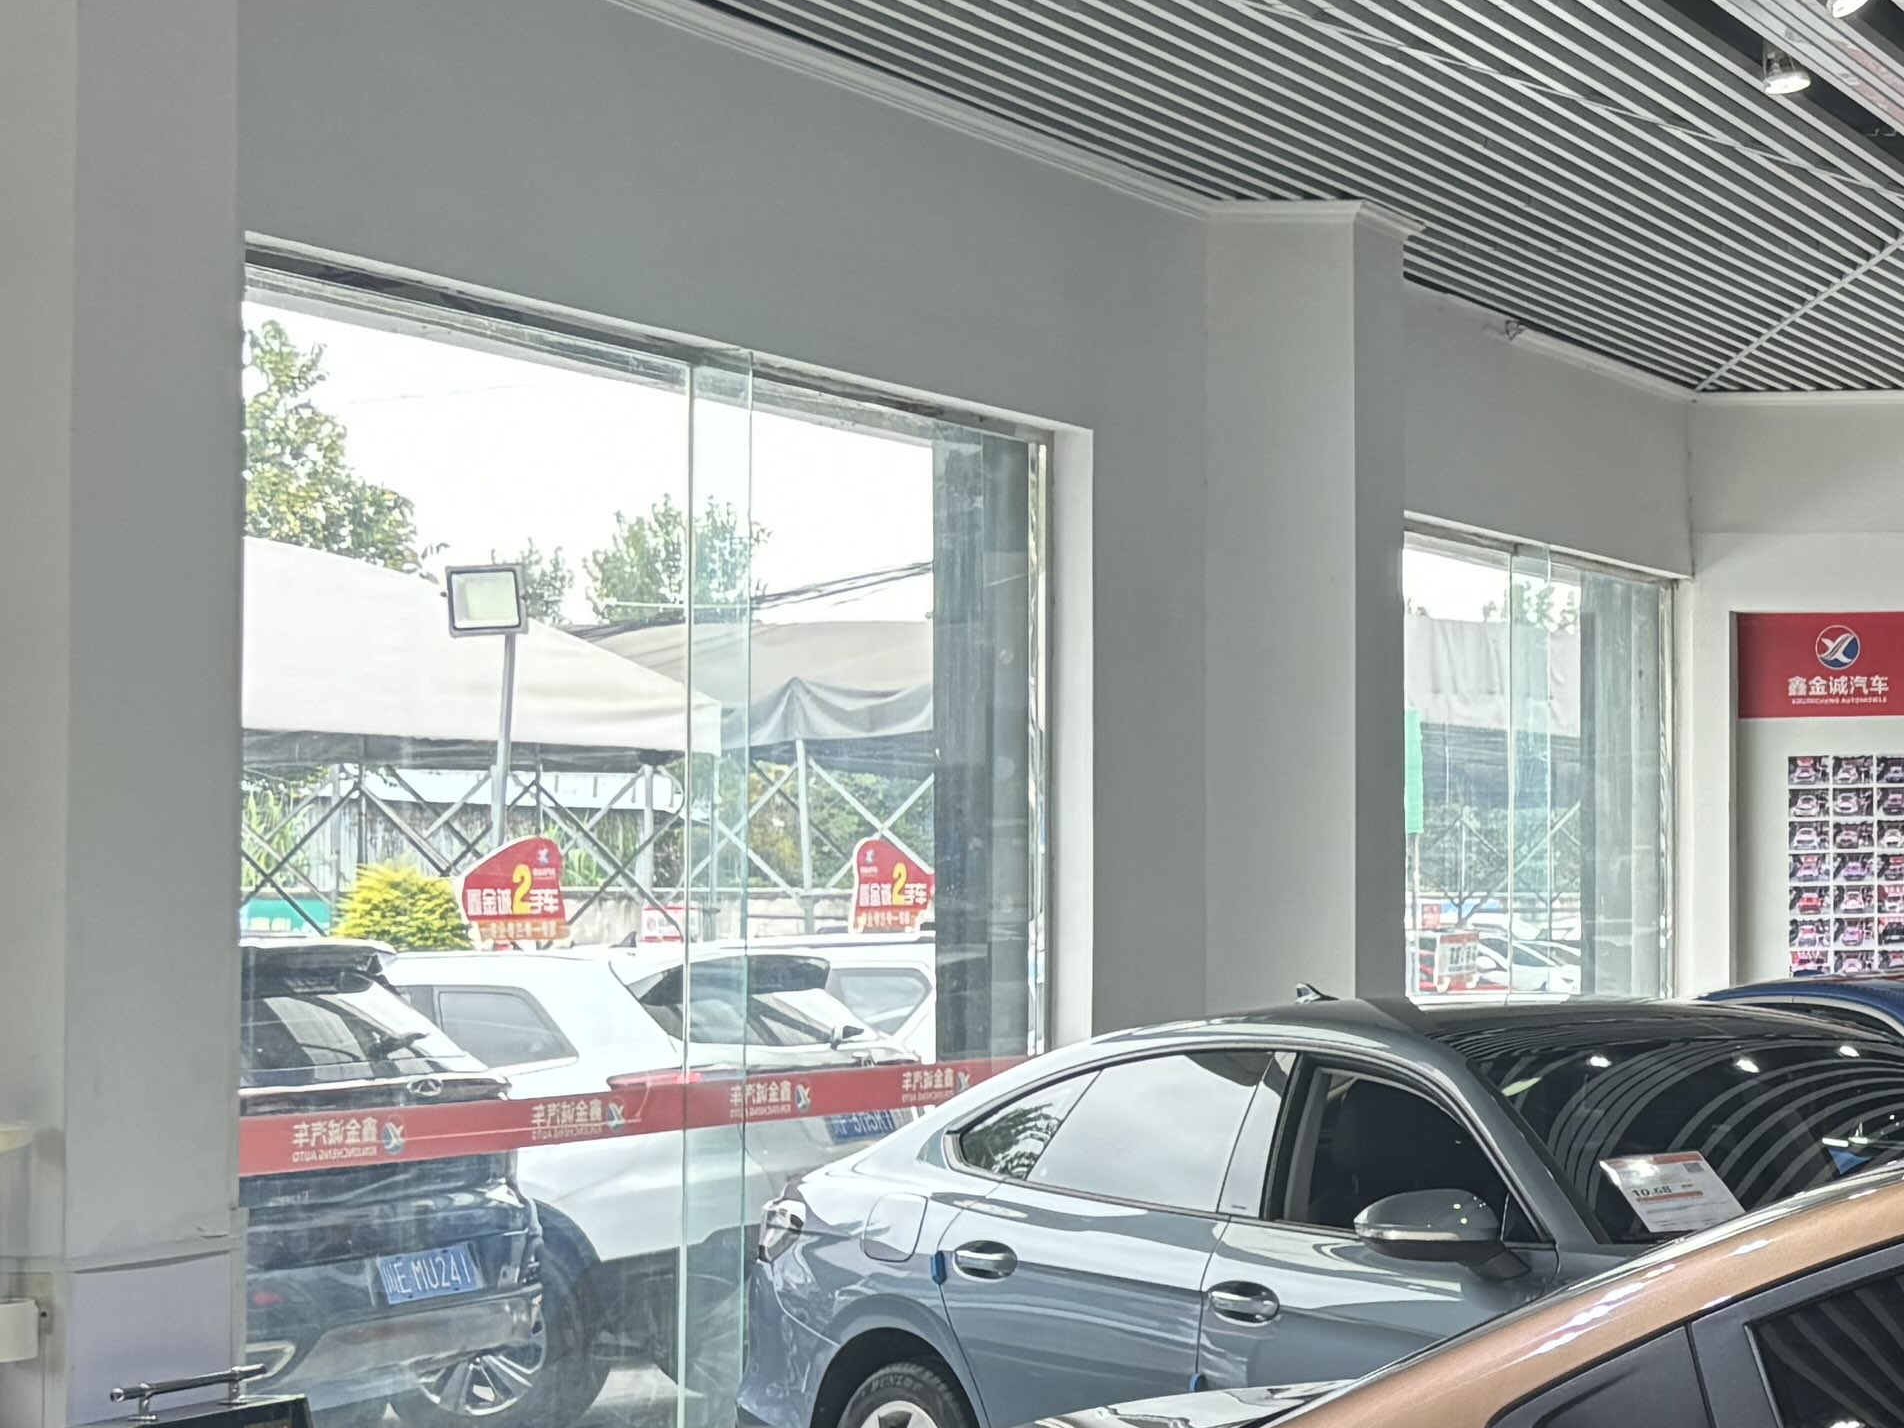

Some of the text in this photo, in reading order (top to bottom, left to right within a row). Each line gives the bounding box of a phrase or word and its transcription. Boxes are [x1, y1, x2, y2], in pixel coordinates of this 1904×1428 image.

[1788, 675, 1889, 696] 鑫金诚汽车
